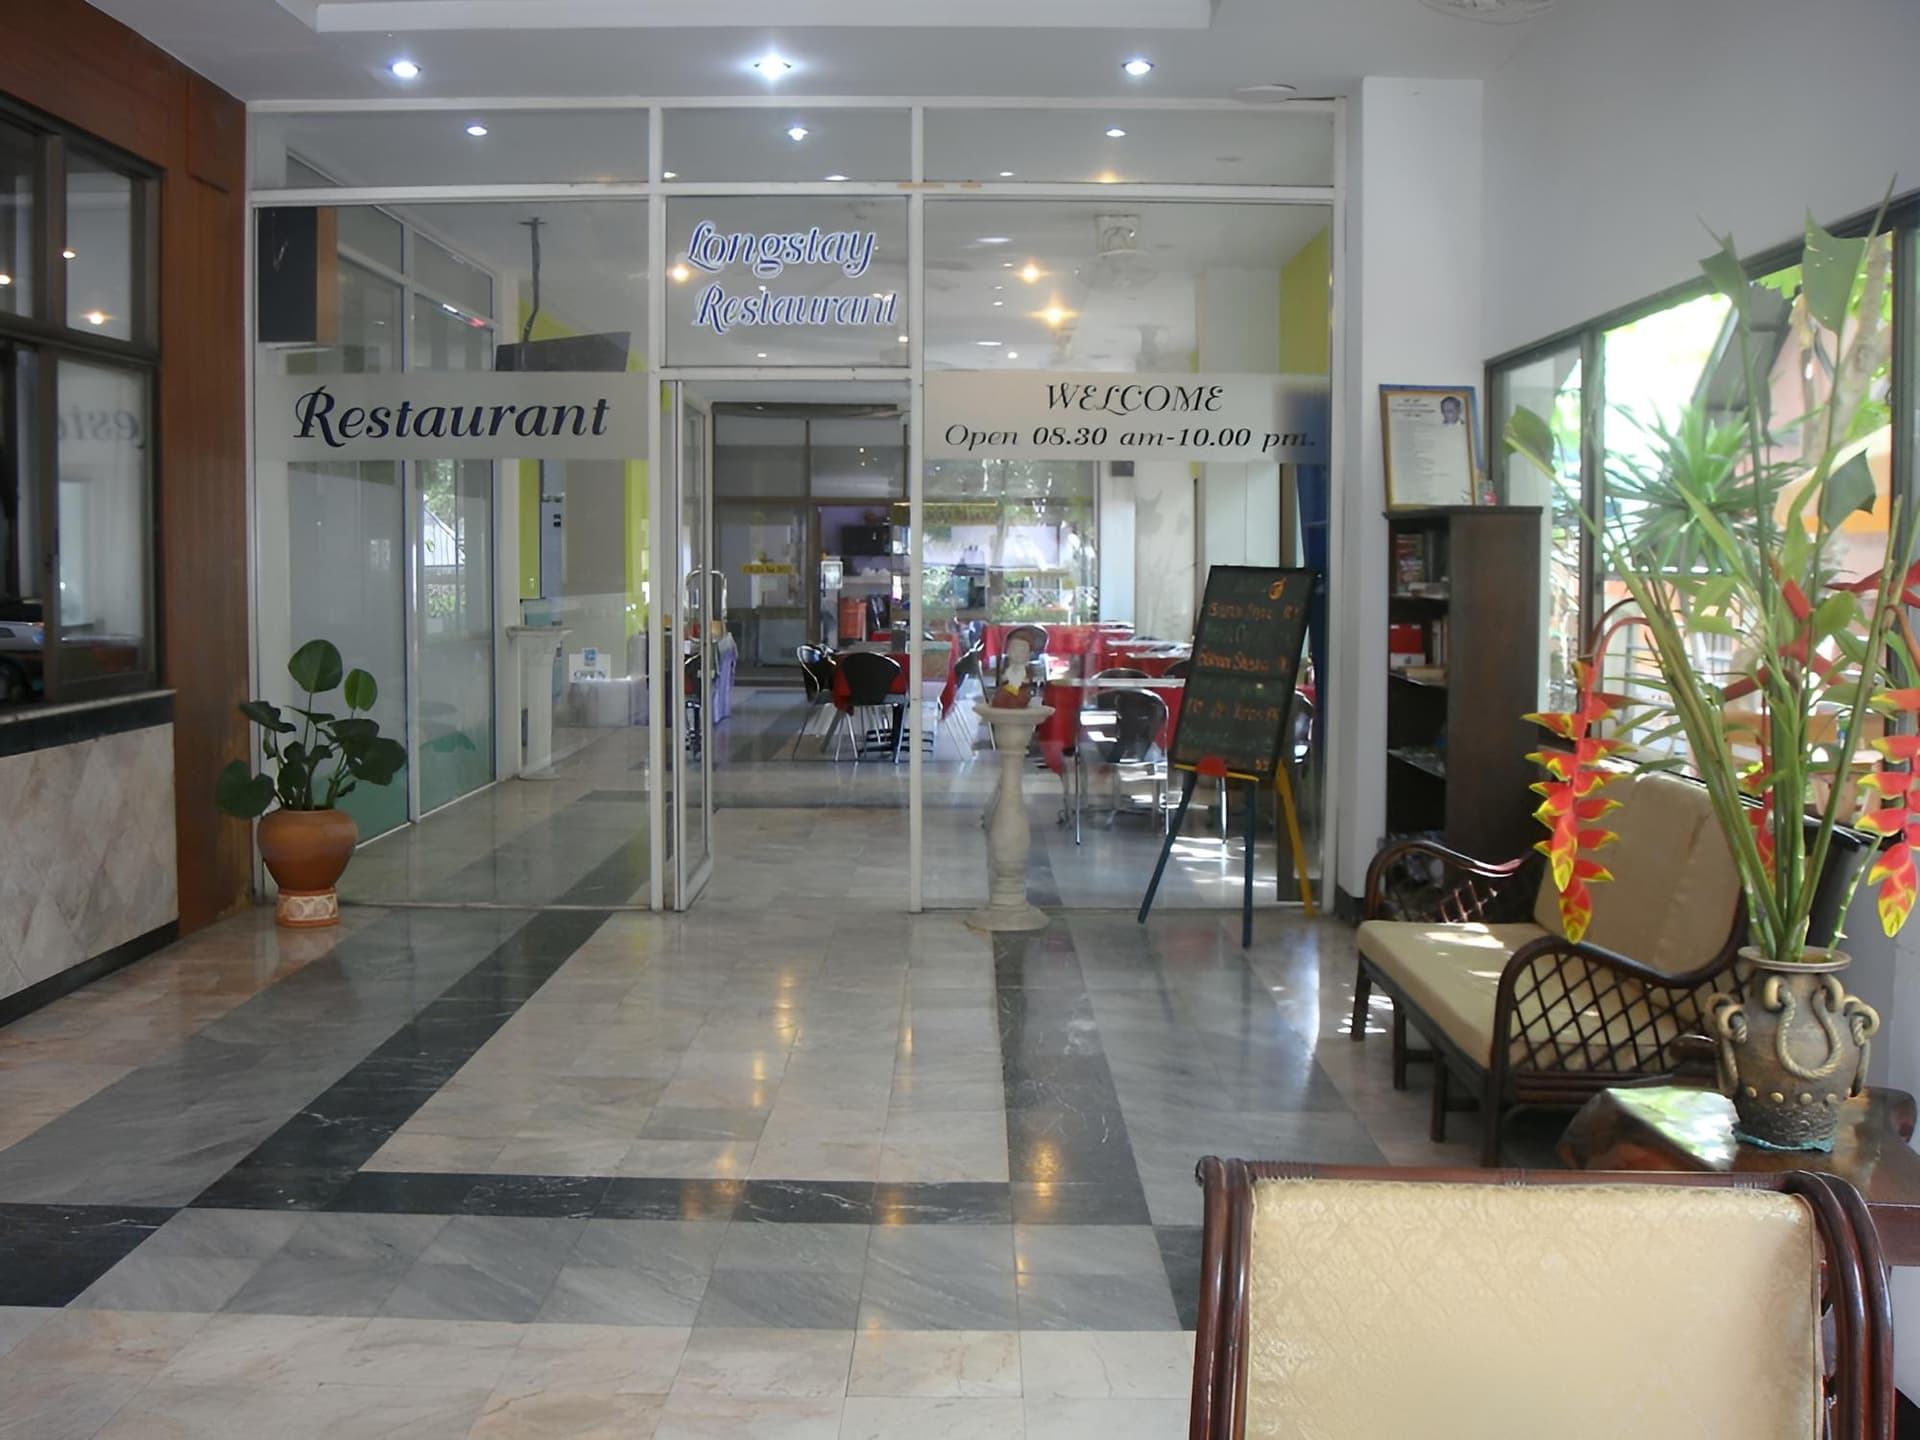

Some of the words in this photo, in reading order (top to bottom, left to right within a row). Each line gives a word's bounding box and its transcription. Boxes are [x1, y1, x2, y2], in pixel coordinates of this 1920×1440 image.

[688, 220, 876, 277] Longstay
[692, 281, 897, 335] Restaurant
[293, 385, 611, 448] Restaurant
[1047, 382, 1223, 416] WELCOME
[945, 424, 1019, 451] Open
[1032, 427, 1108, 446] 08.30
